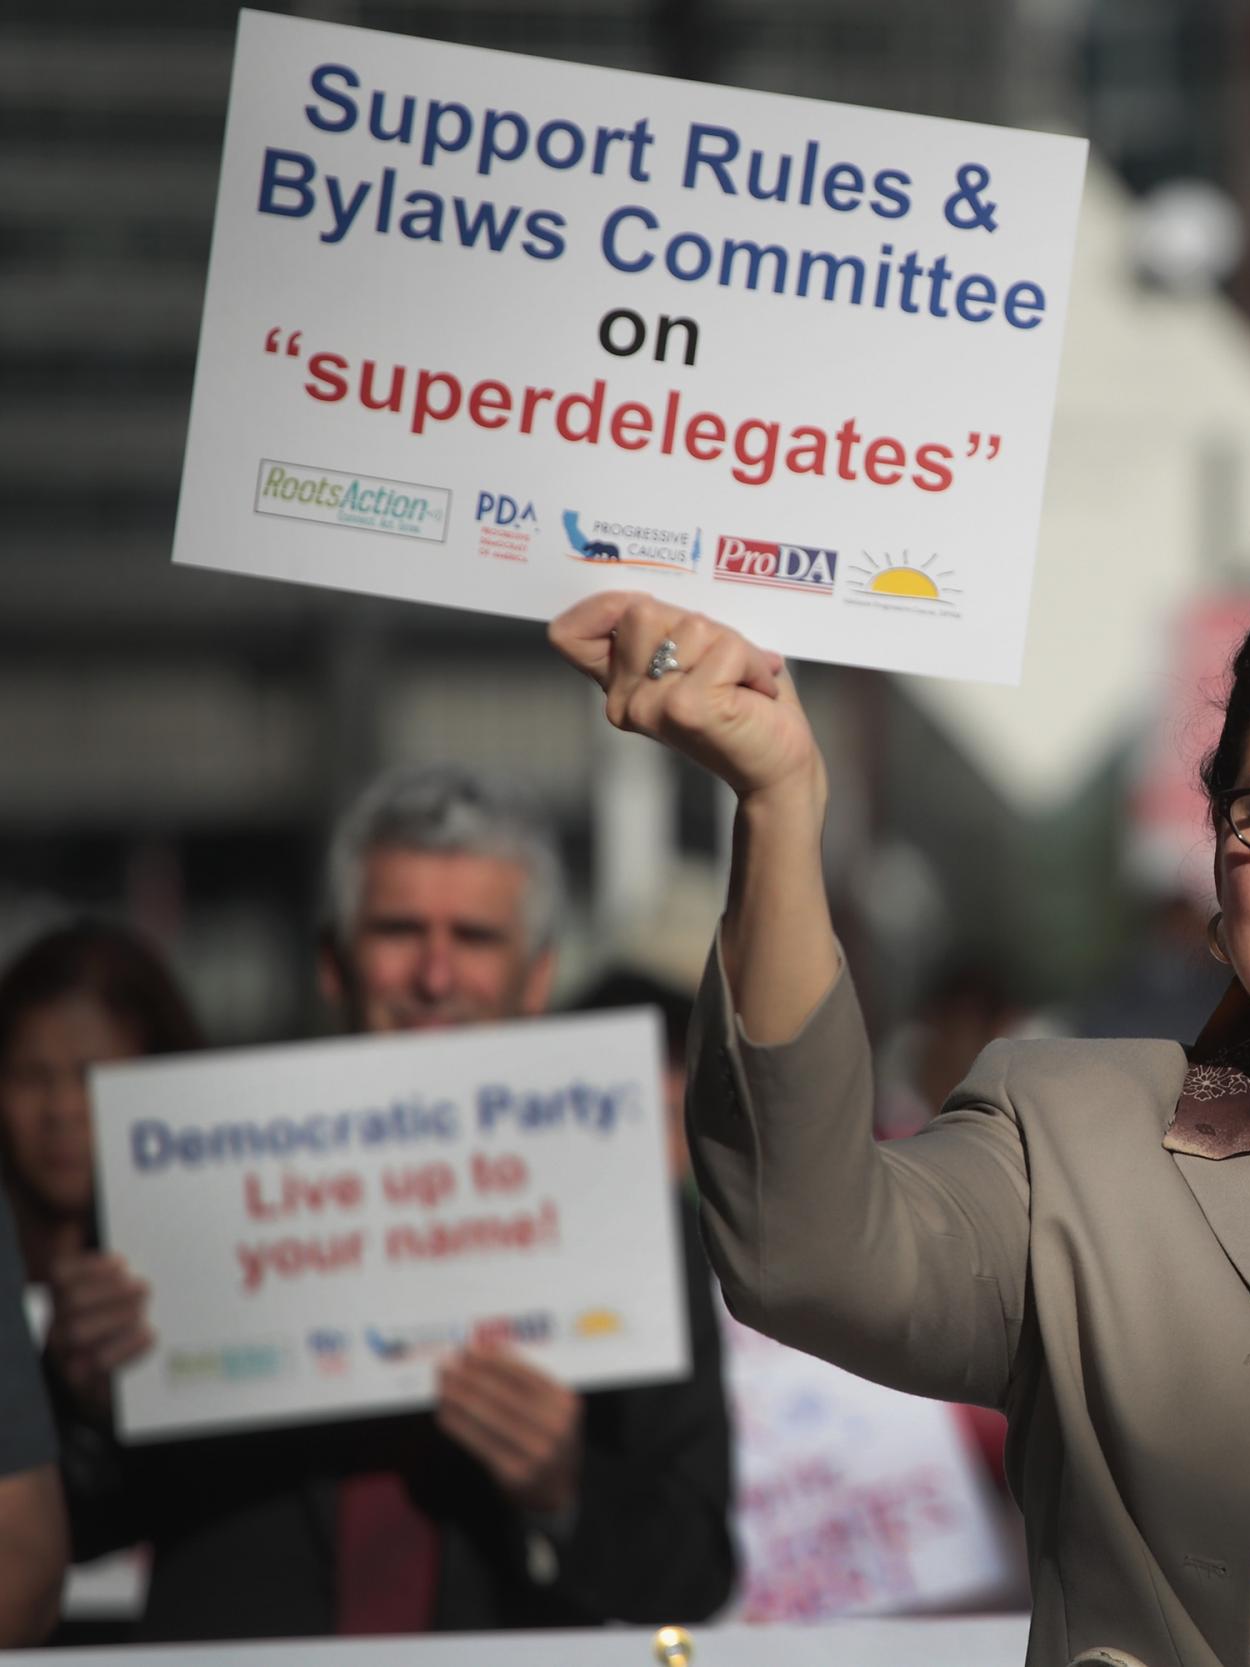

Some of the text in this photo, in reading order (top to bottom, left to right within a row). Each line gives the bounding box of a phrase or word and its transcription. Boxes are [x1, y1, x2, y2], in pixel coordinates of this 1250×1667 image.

[305, 65, 997, 233] Support Rules &
[258, 149, 1045, 329] Bylaws Committee
[598, 308, 699, 366] on
[266, 329, 1000, 492] “superdelegates”
[262, 465, 429, 521] RootsAction
[475, 490, 537, 526] PDA
[593, 520, 689, 545] PROGRESSIVE
[628, 542, 687, 562] CAUCUS
[716, 537, 834, 585] ProDA
[130, 1094, 455, 1174] Democratic
[243, 1151, 530, 1222] Live up to
[235, 1200, 561, 1294] your name!
